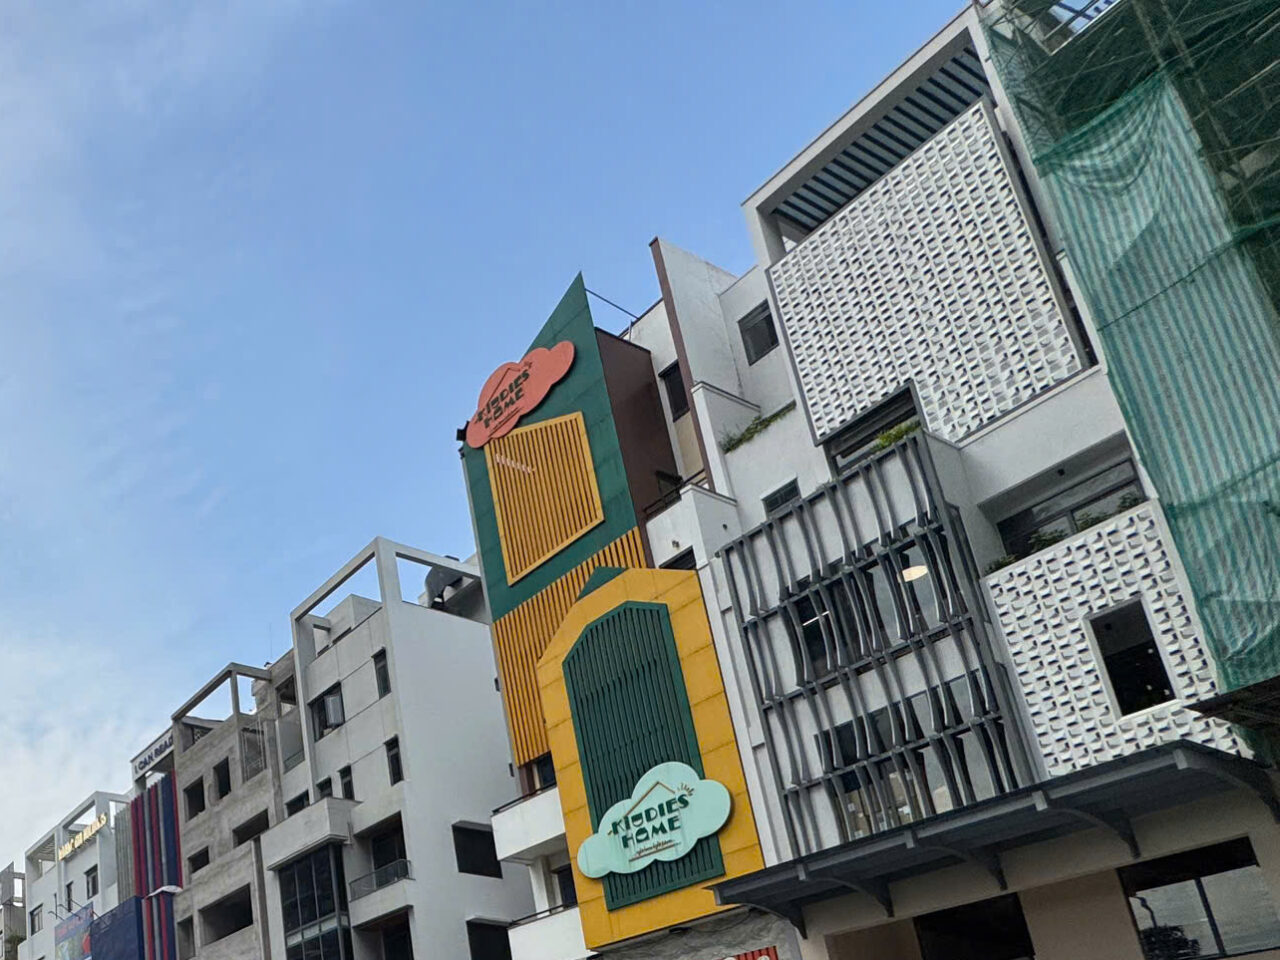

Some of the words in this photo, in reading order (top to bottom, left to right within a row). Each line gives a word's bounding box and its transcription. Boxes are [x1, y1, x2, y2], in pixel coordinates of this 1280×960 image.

[484, 387, 524, 429] HOME
[612, 794, 689, 835] KIDDIES
[622, 816, 681, 849] HOME
